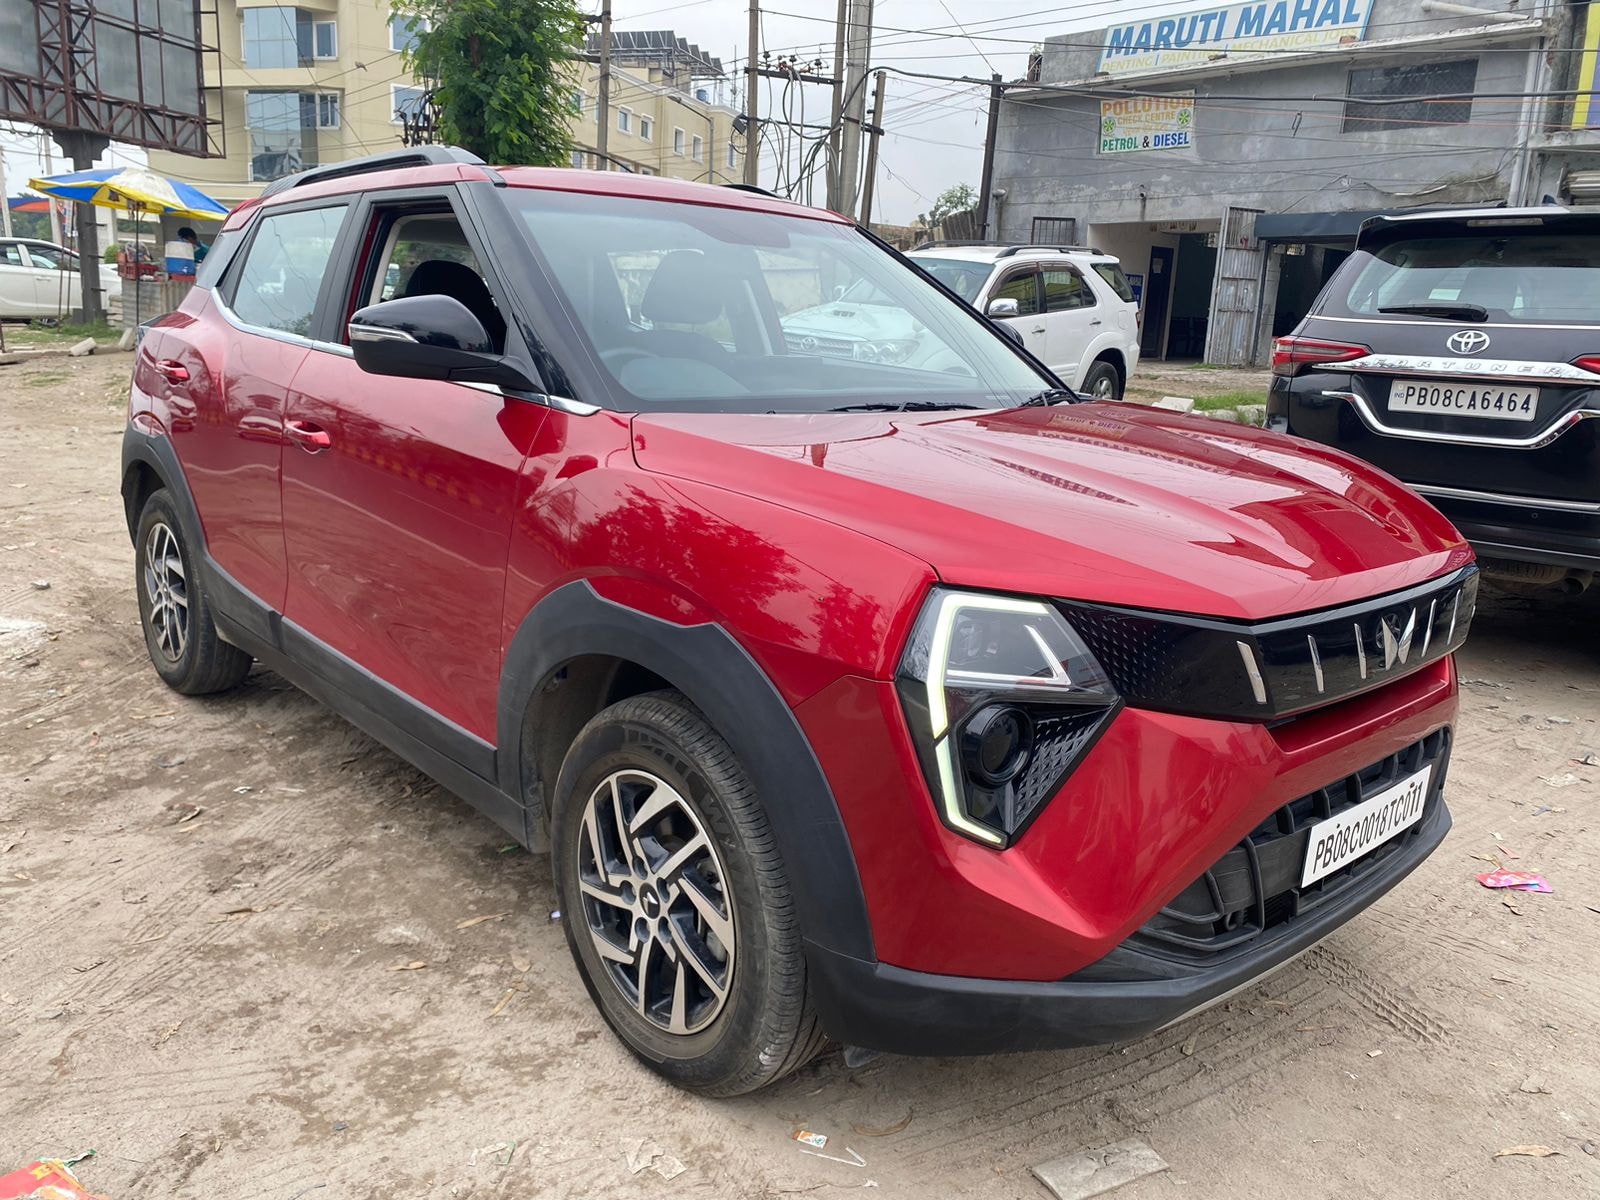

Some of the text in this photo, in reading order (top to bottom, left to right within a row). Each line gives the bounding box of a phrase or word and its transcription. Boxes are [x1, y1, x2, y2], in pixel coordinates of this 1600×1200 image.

[1106, 0, 1361, 58] MARUTI MAHAL
[1102, 97, 1193, 117] POLLUTION
[1102, 132, 1190, 151] PETROL & DIESEL
[1404, 386, 1532, 413] PB08CA6464
